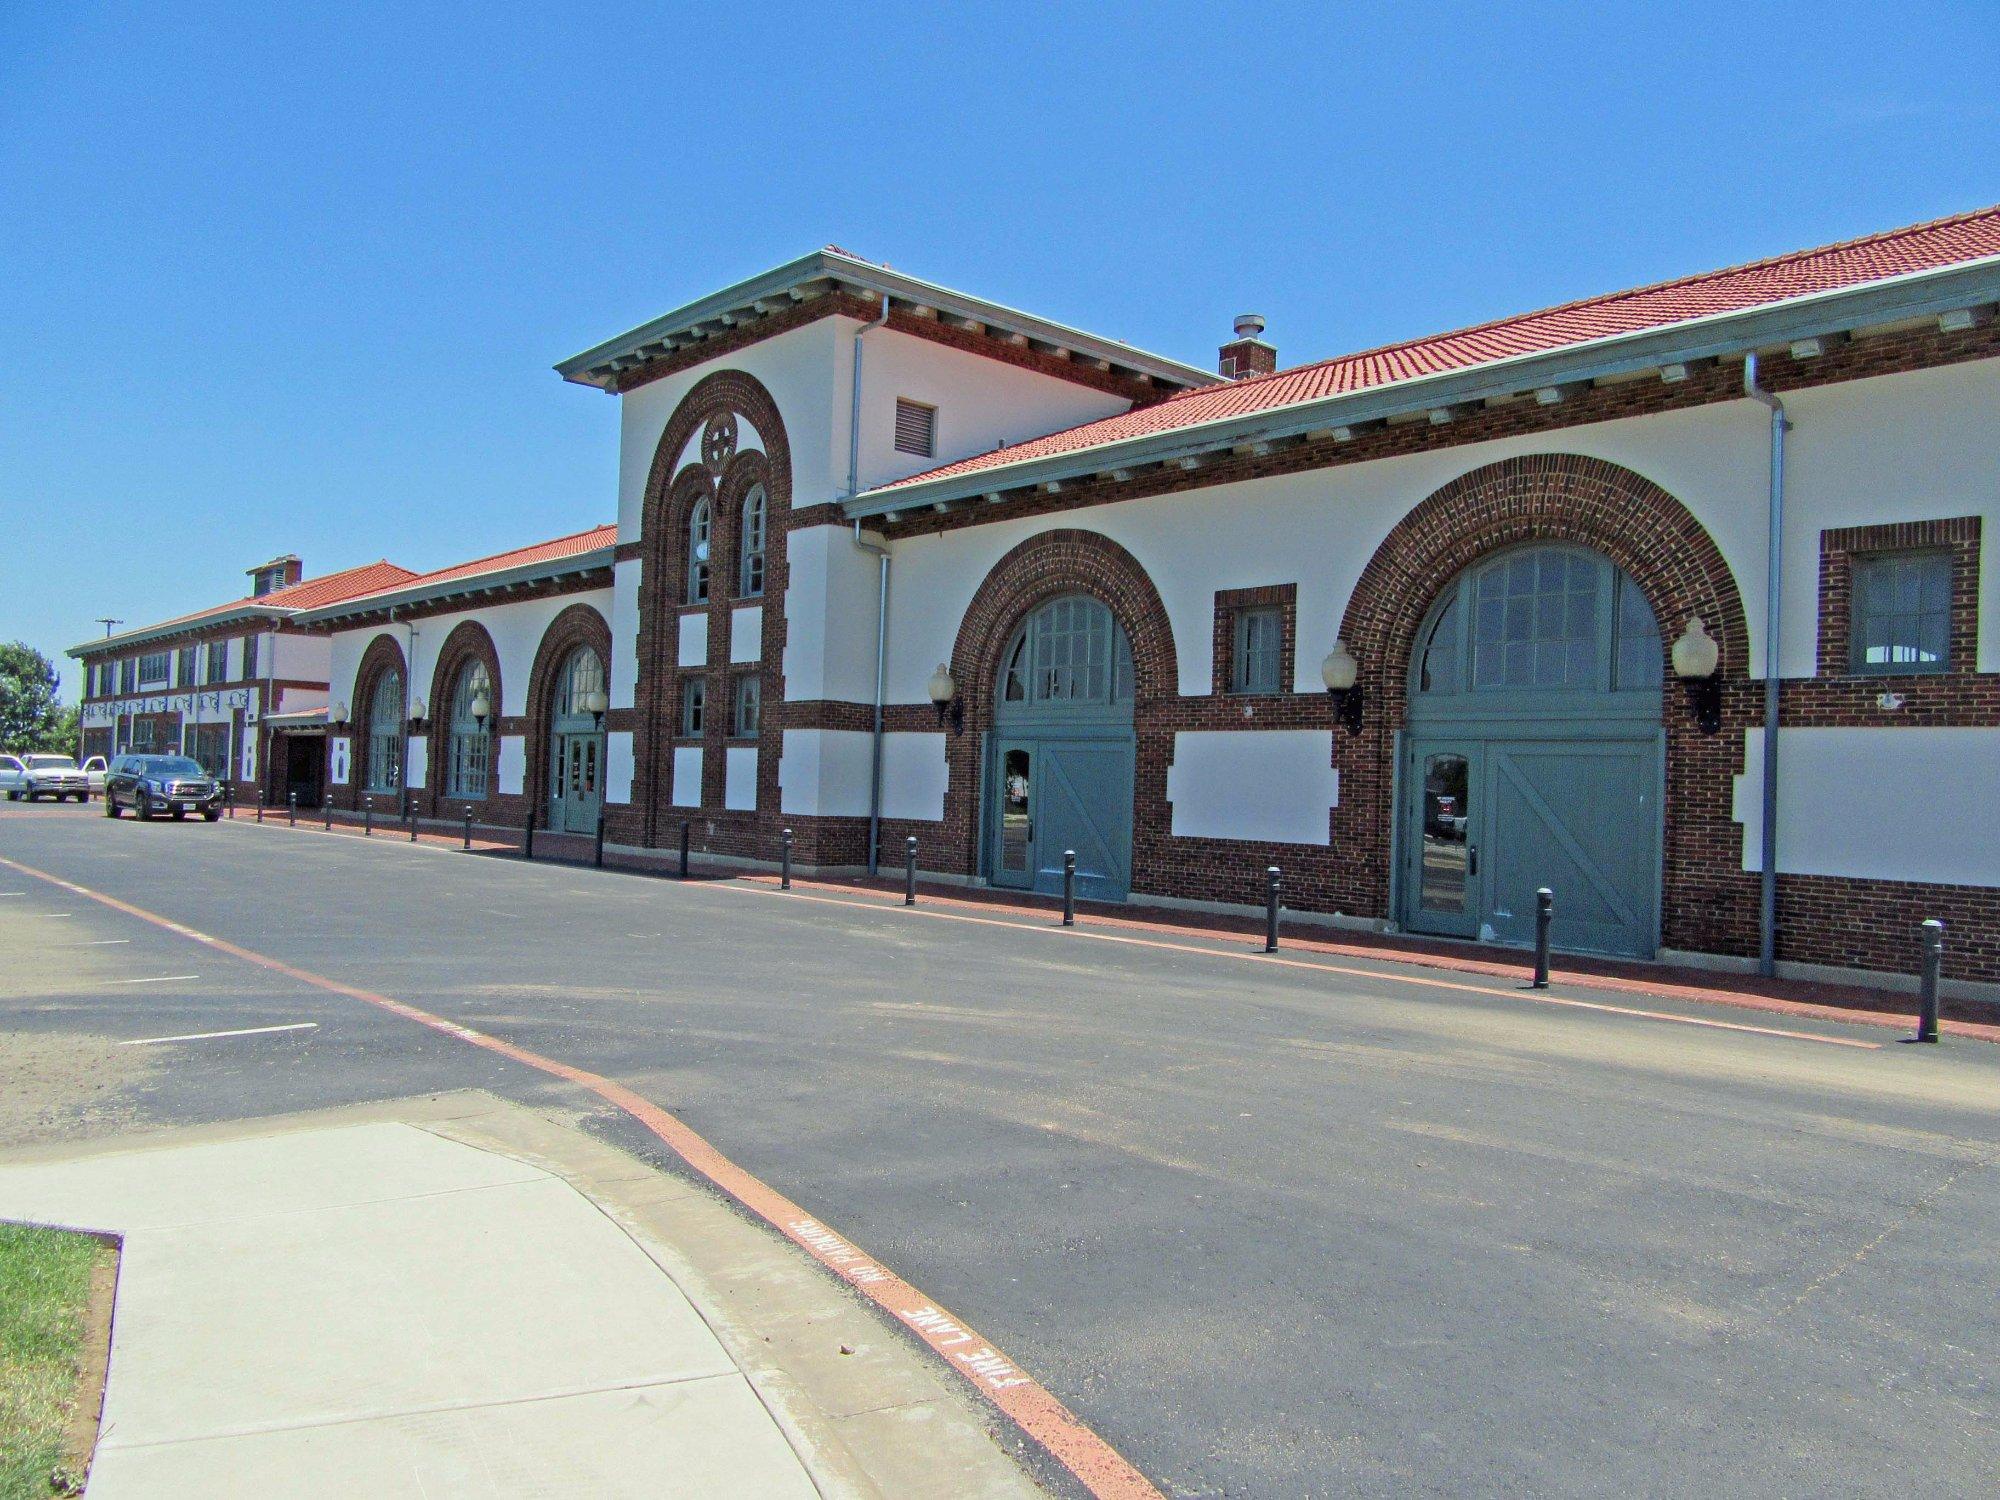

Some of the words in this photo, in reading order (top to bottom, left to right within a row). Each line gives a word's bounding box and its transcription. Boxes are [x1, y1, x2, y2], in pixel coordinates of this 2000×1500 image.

[788, 1220, 862, 1263] PARKING
[848, 1266, 886, 1282] NO
[900, 1306, 972, 1345] LANE
[955, 1347, 1029, 1388] FIRE
